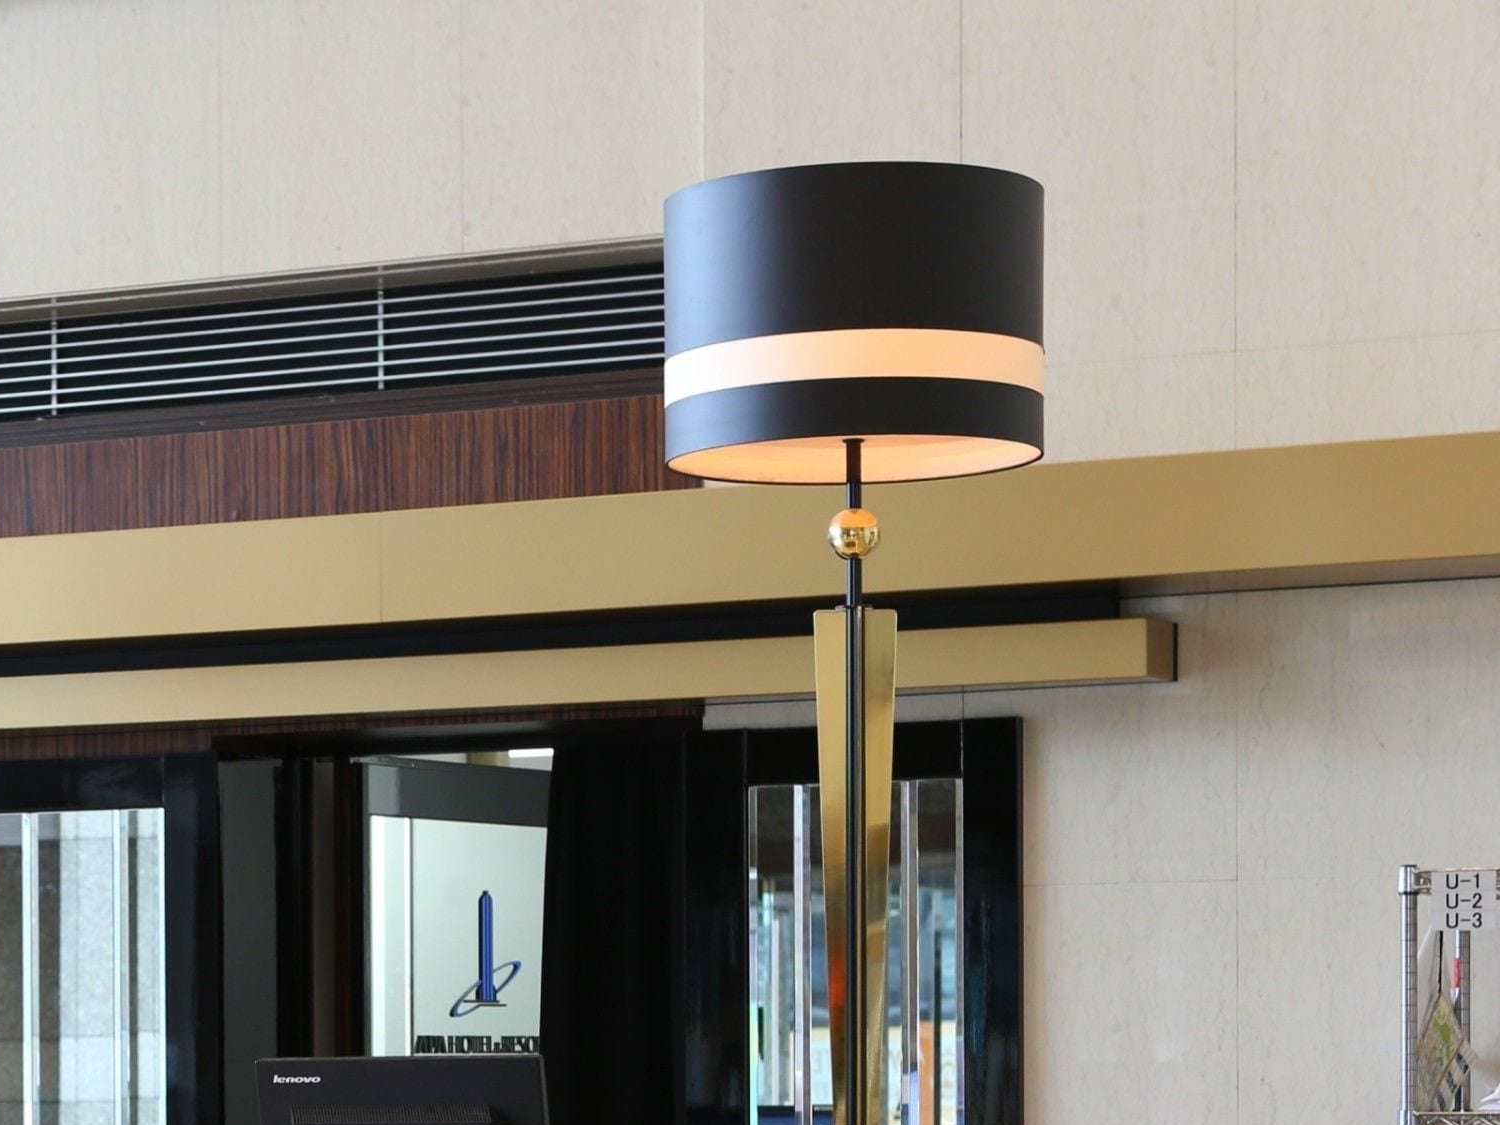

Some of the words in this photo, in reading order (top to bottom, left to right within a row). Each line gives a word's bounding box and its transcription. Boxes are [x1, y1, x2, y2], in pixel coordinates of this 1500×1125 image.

[1445, 873, 1480, 890] U-1
[1445, 892, 1483, 909] U-2
[1445, 912, 1483, 929] U-3
[273, 1074, 321, 1084] lenovo
